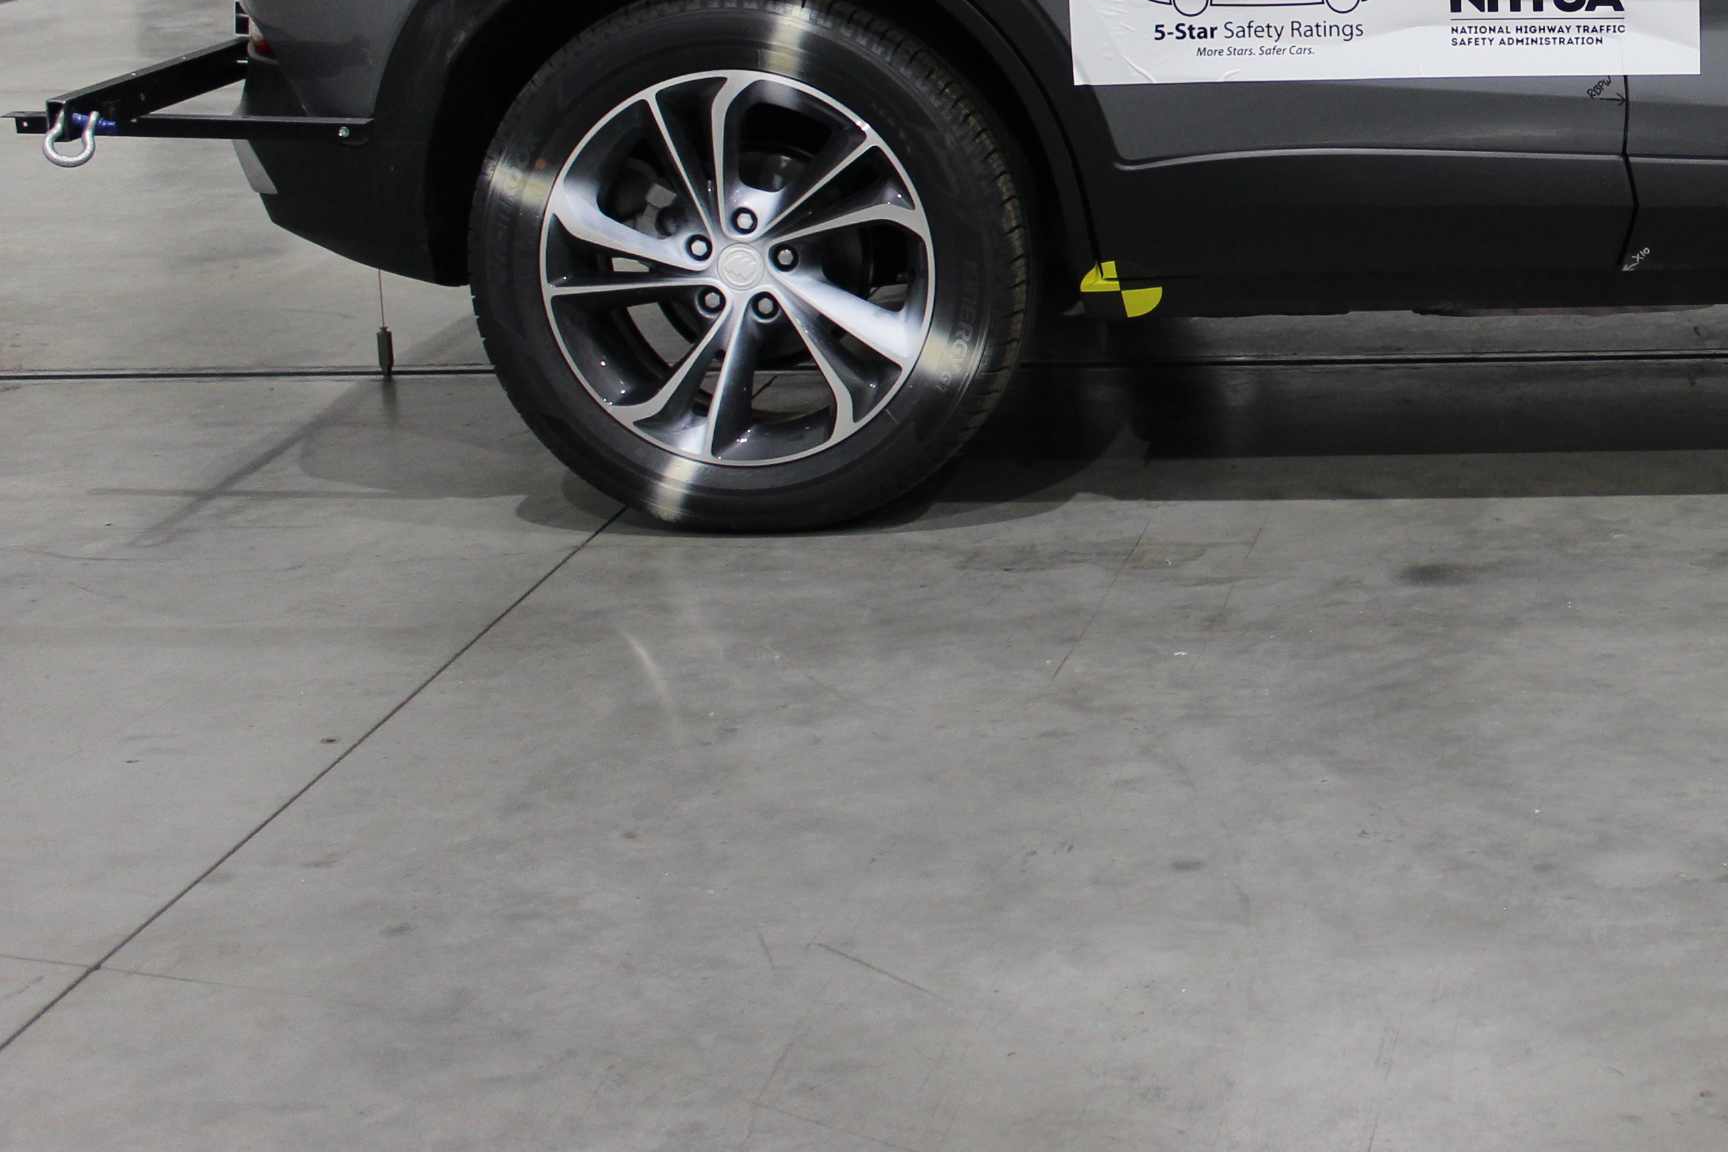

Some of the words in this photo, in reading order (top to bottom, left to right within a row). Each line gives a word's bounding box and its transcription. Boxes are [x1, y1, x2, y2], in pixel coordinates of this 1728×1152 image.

[1154, 22, 1218, 41] 5-Star
[1223, 20, 1285, 42] Safety
[1290, 20, 1364, 42] Ratings
[1451, 25, 1511, 35] NATIONAL
[1515, 25, 1572, 34] HIGHWAY
[1575, 24, 1626, 34] TRAFFIC
[1451, 37, 1495, 46] SAFETY
[1499, 36, 1603, 46] ADMINISTRATION
[1196, 46, 1224, 57] More
[1226, 46, 1256, 57] Stars.
[1259, 45, 1286, 56] Safer
[1289, 45, 1315, 56] Cars.
